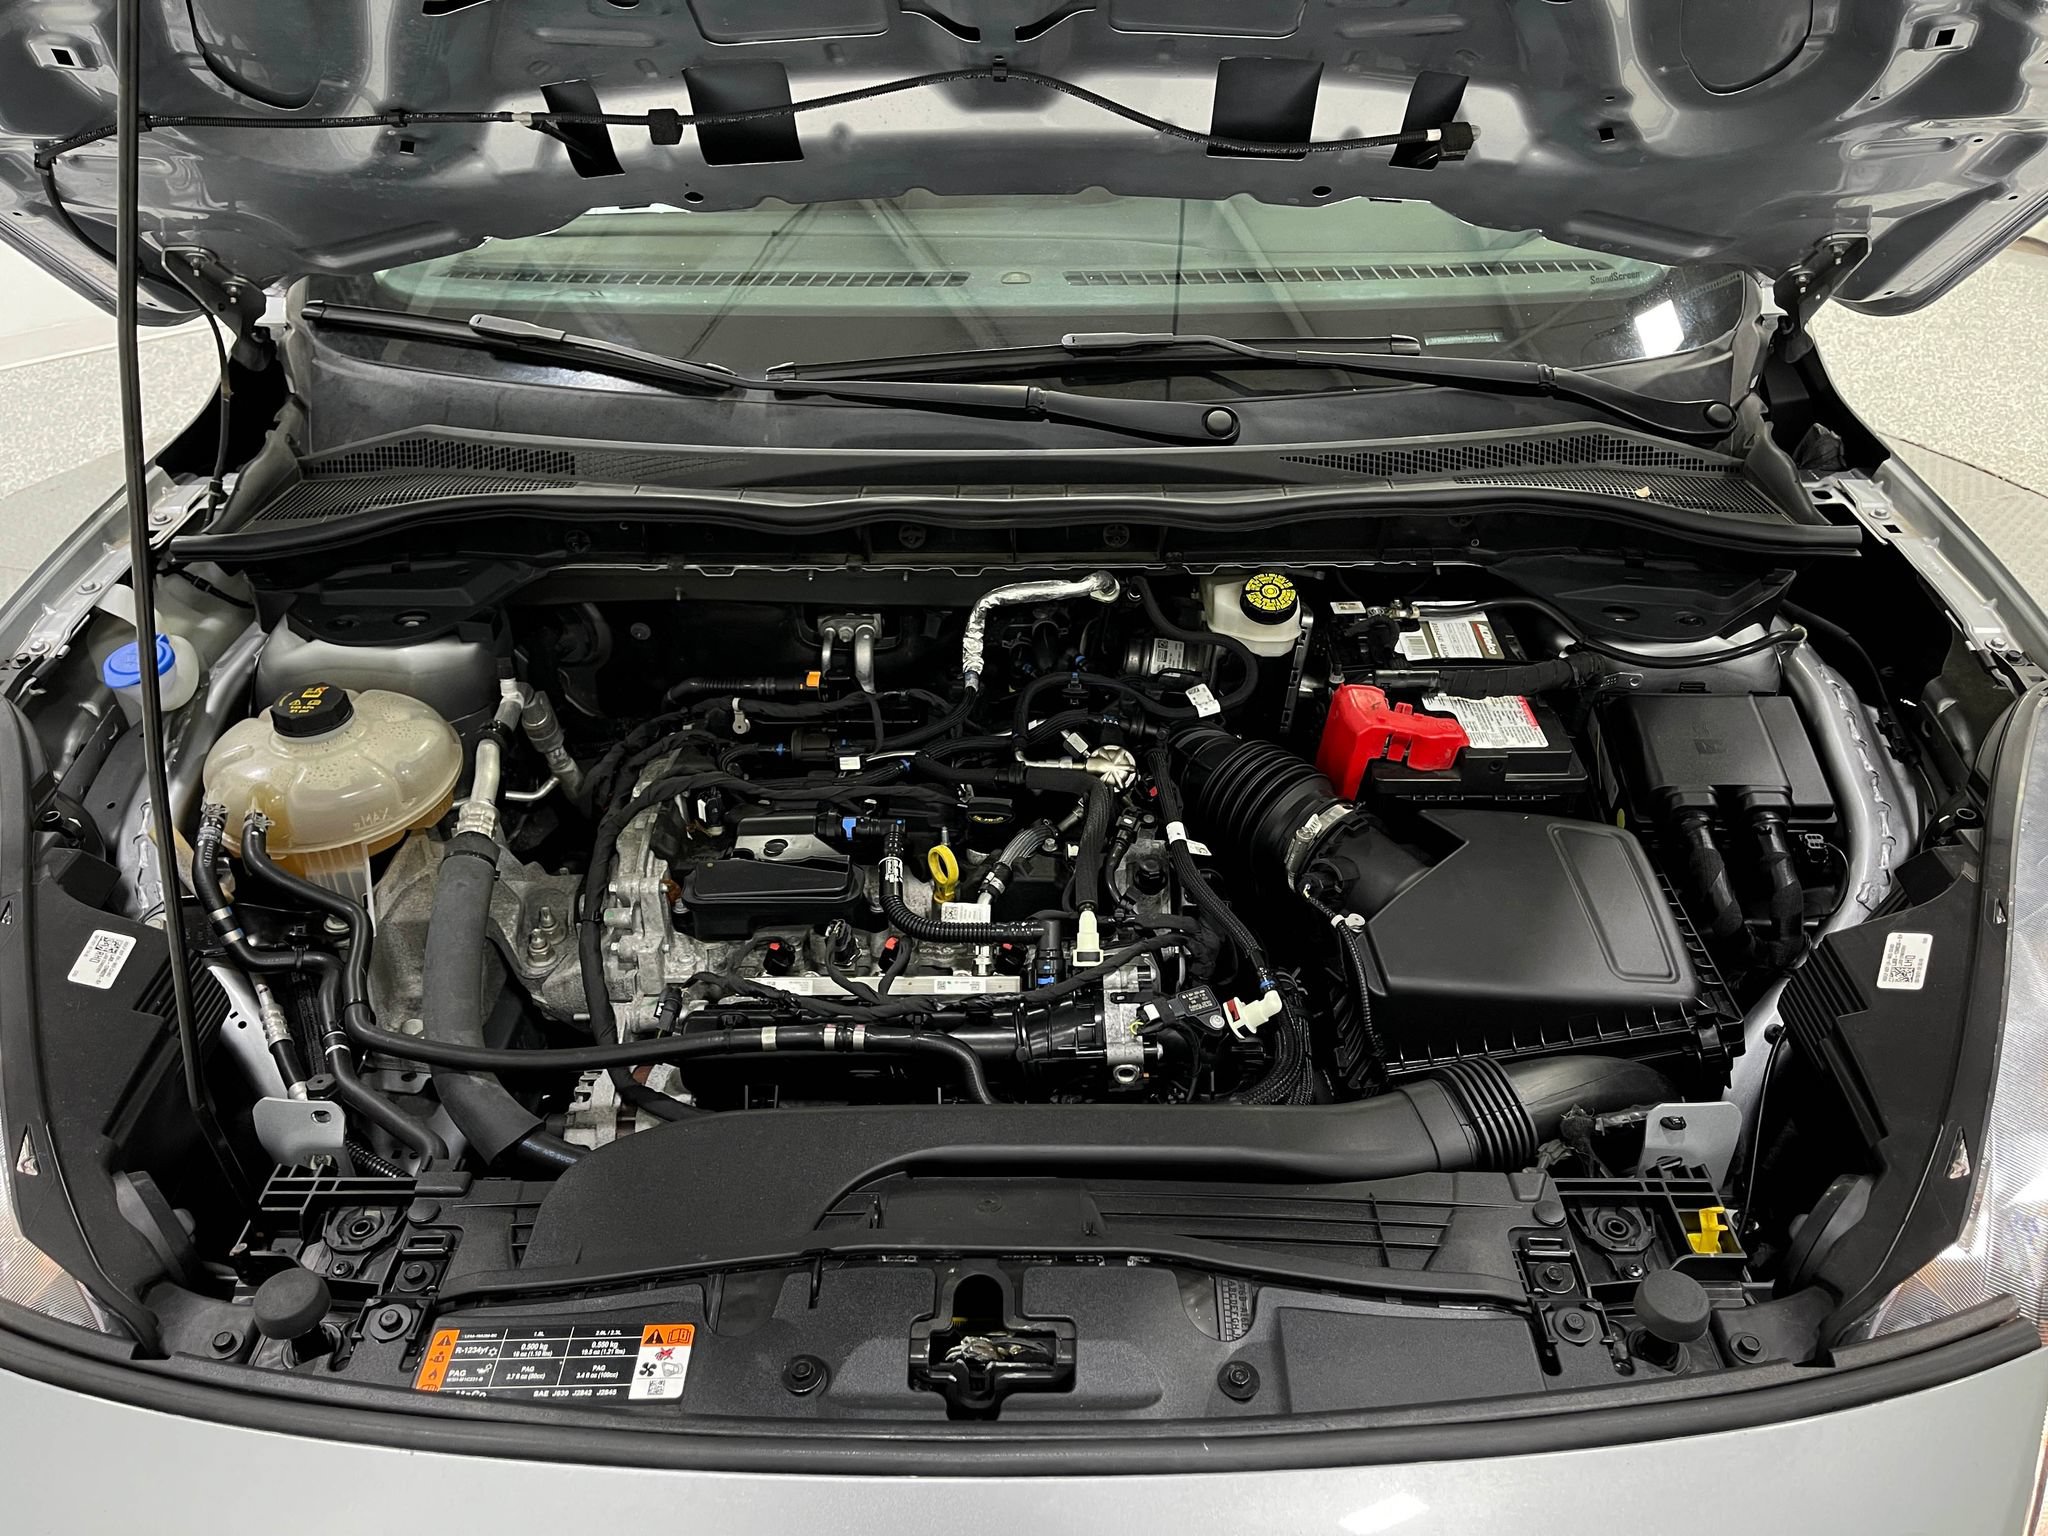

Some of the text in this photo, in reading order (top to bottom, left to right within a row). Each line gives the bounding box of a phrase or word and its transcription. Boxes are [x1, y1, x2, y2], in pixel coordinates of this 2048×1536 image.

[1590, 271, 1640, 285] SoundScreen
[1476, 623, 1498, 655] ACDelco
[520, 1342, 549, 1351] 0.500 kg
[609, 1340, 619, 1349] kg
[454, 1345, 490, 1356] R-1234yf
[520, 1365, 535, 1373] PAG
[592, 1364, 606, 1372] PAG
[448, 1369, 467, 1377] PAG
[533, 1389, 550, 1398] SAE
